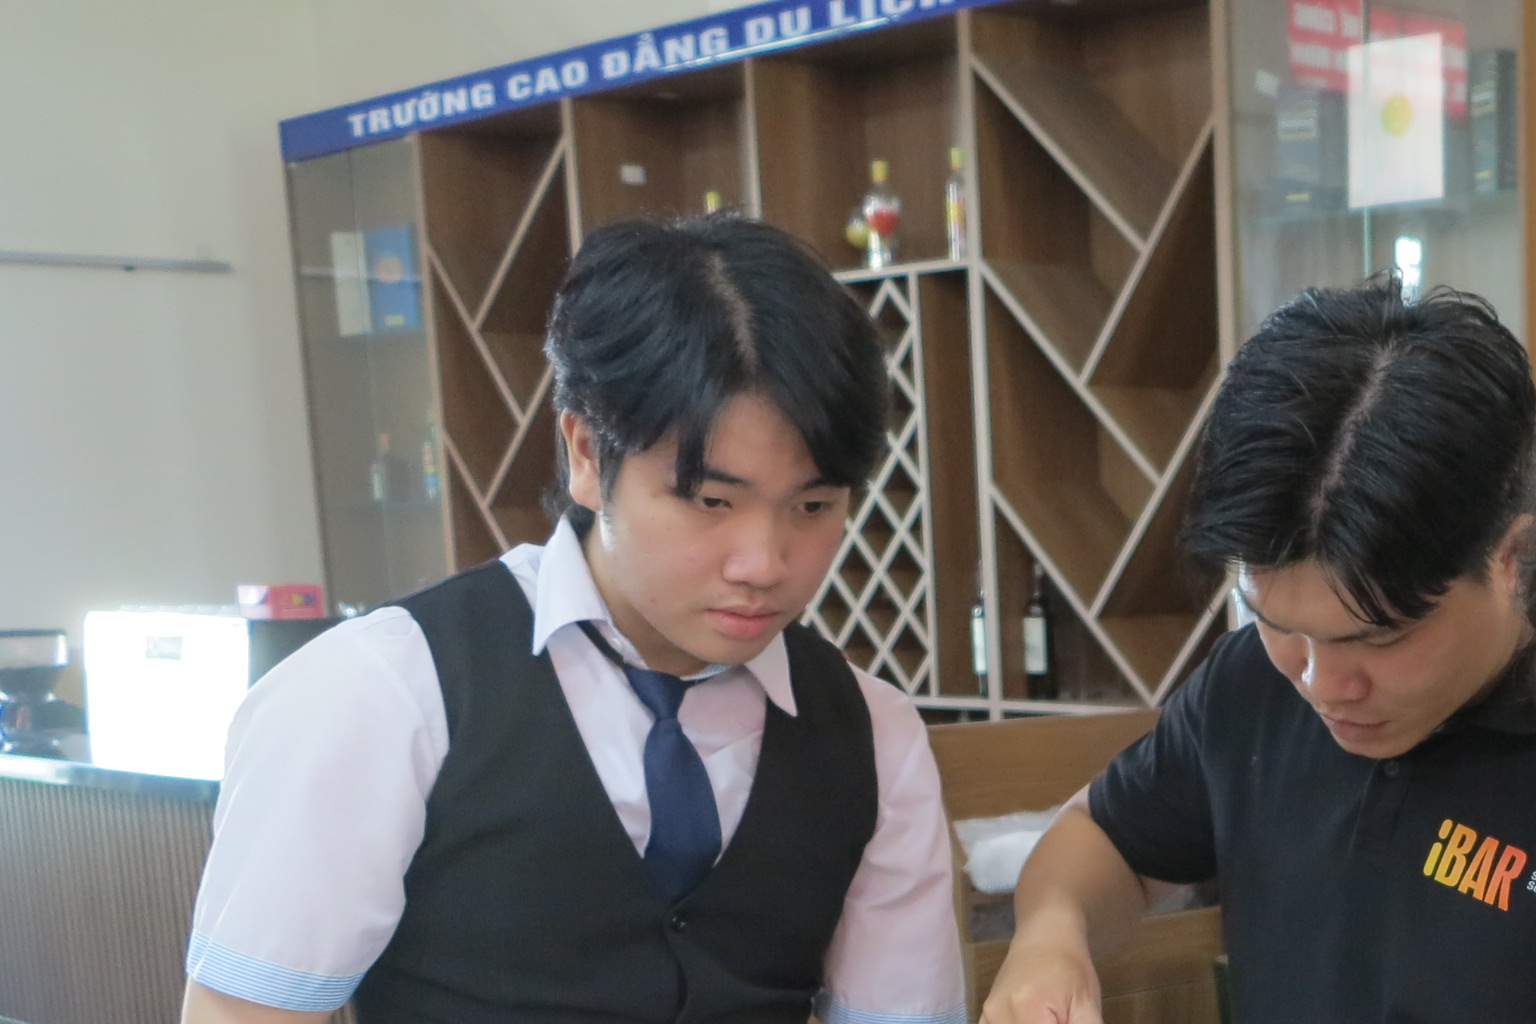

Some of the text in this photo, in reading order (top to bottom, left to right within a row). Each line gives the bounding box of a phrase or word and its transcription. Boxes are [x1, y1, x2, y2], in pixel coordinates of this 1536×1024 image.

[348, 82, 496, 138] TRƯỜNG
[507, 60, 589, 101] CAO
[601, 26, 730, 80] ĐẲNG
[744, 7, 812, 47] DU
